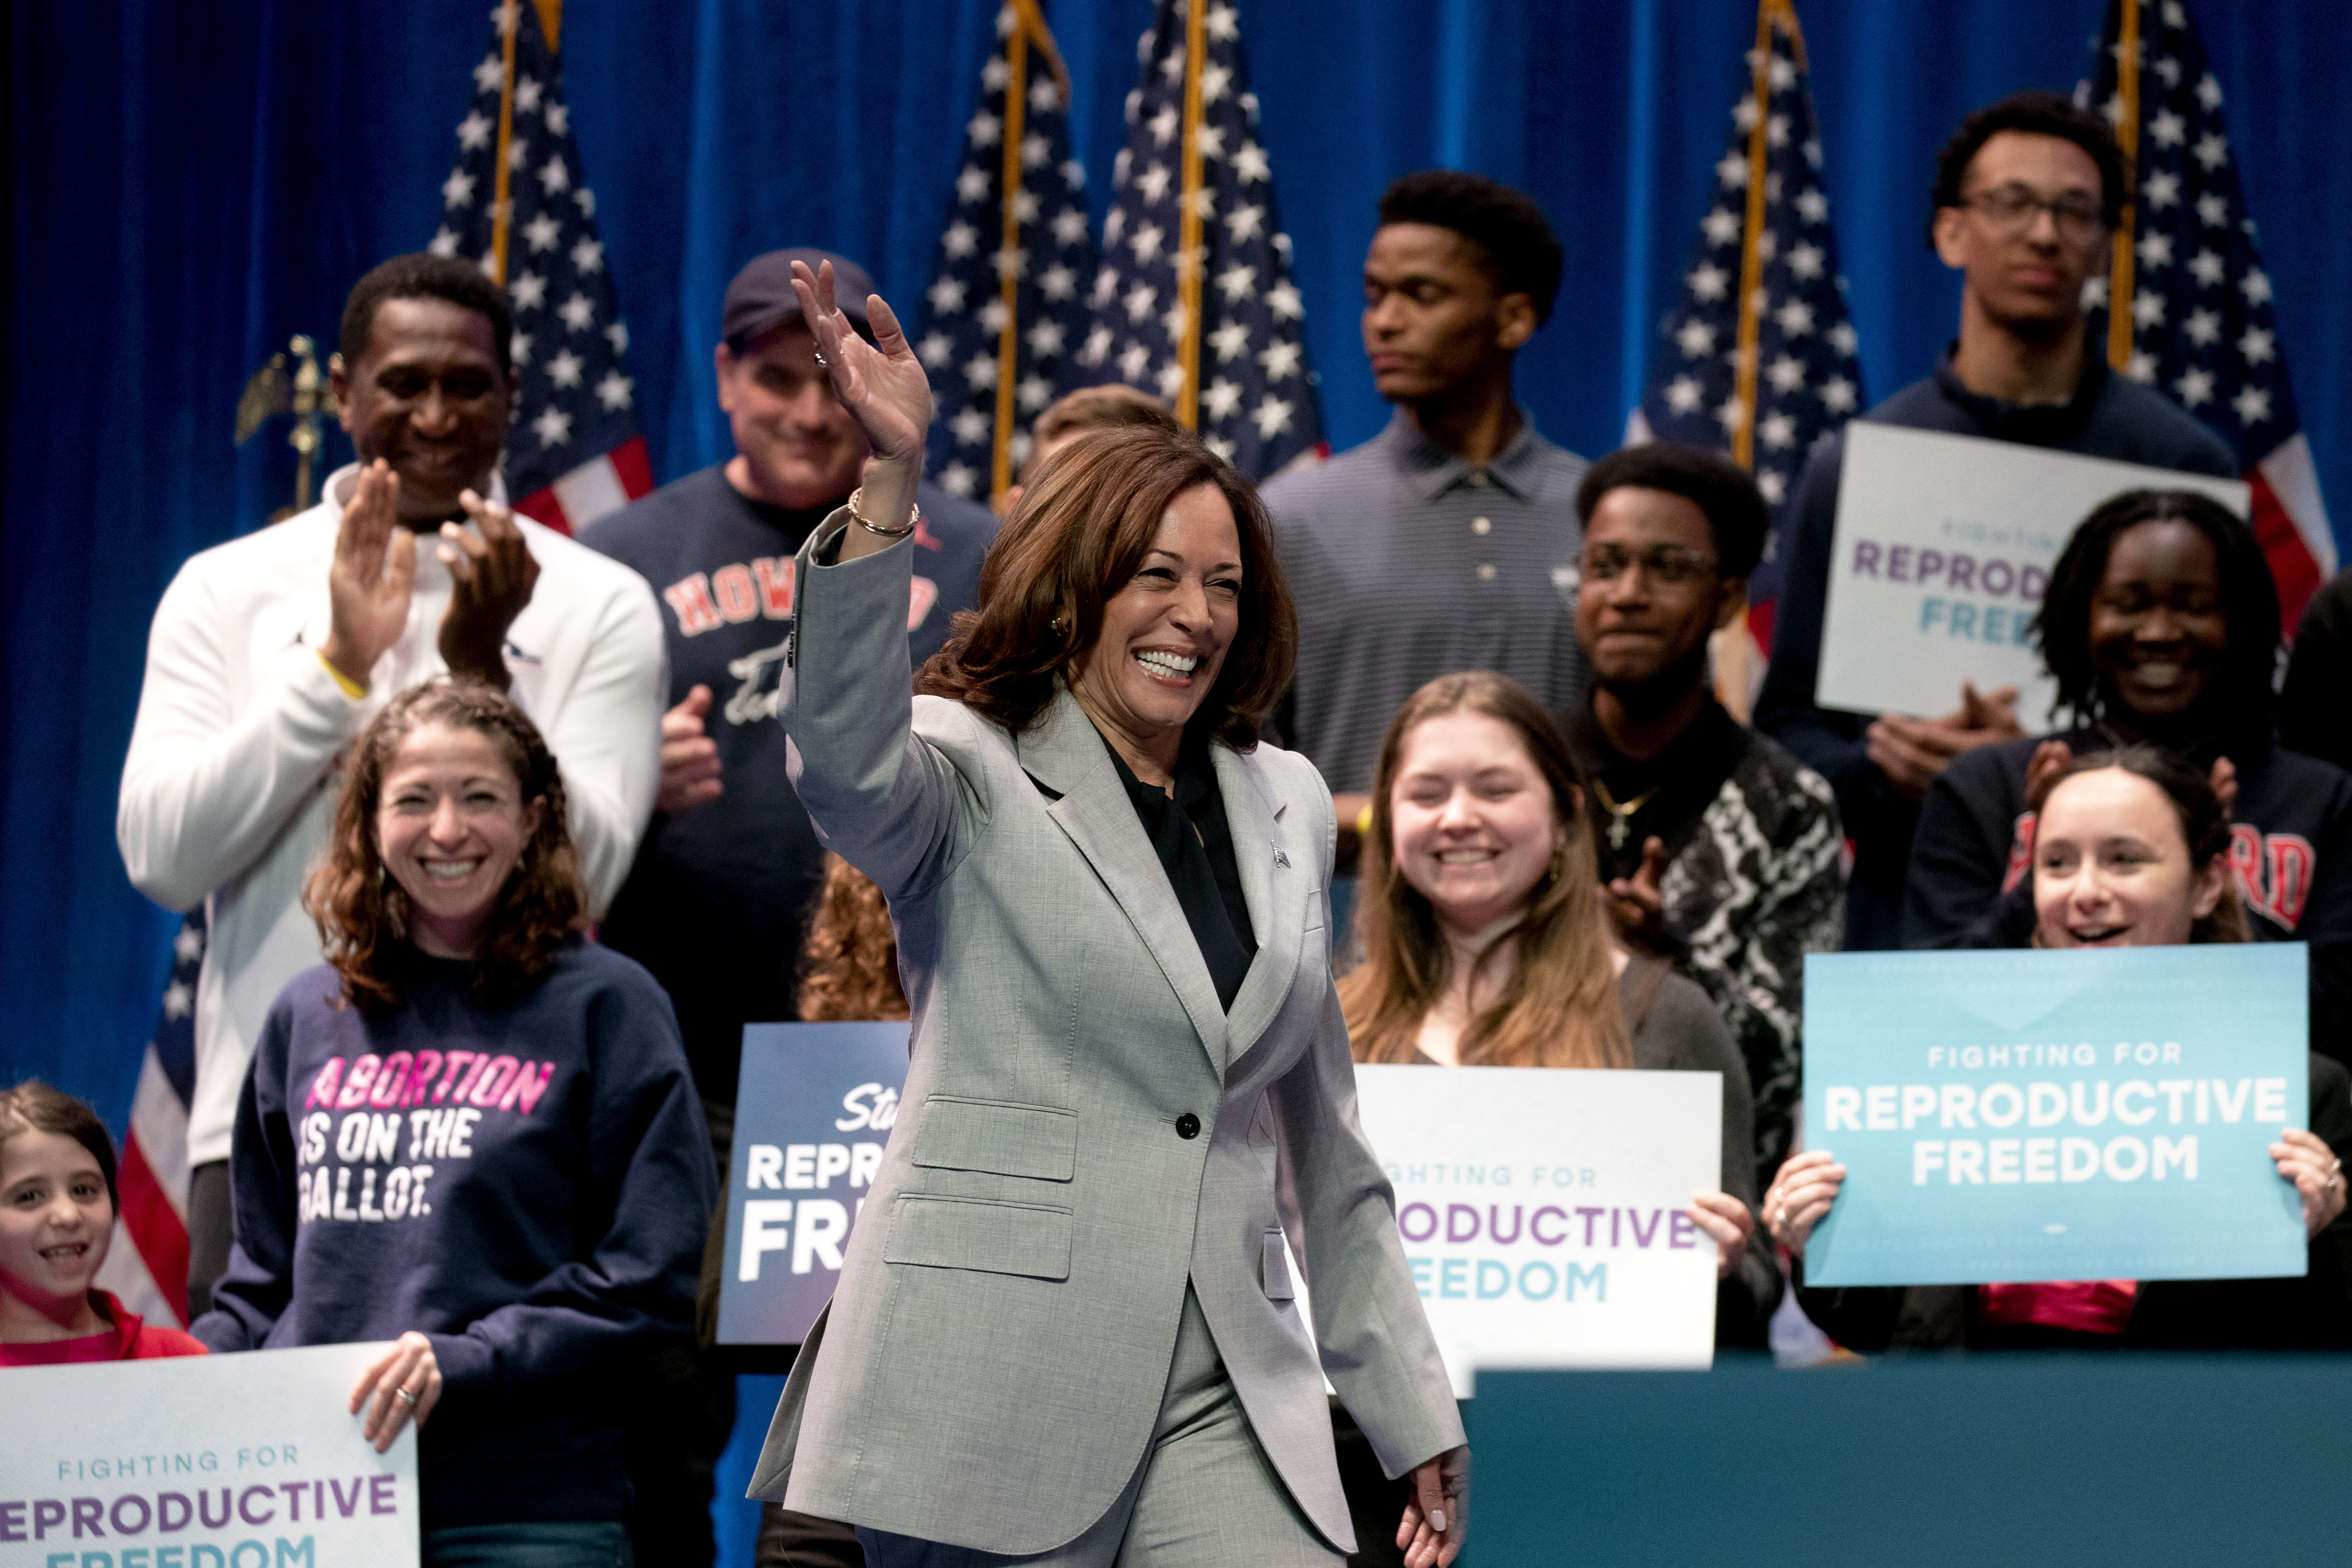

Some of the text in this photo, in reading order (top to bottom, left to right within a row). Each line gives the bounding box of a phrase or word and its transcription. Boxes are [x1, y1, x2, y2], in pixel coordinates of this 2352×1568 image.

[664, 556, 938, 637] HOW
[1927, 1042, 2181, 1069] FIGHTING FOR
[305, 1050, 556, 1115] ABORTION
[1825, 1077, 2287, 1131] REPRODUCTIVE
[336, 1111, 401, 1163] ON
[409, 1108, 482, 1160] THE
[1913, 1135, 2198, 1185] FREEDOM
[1532, 1166, 1597, 1189] FOR
[738, 1197, 865, 1282] FR
[1398, 1201, 1696, 1250] ODUCTIVE
[1407, 1257, 1608, 1303] EEDOM
[58, 1445, 298, 1481] FIGHTING FOR
[0, 1474, 397, 1542] EPRODUCTIVE
